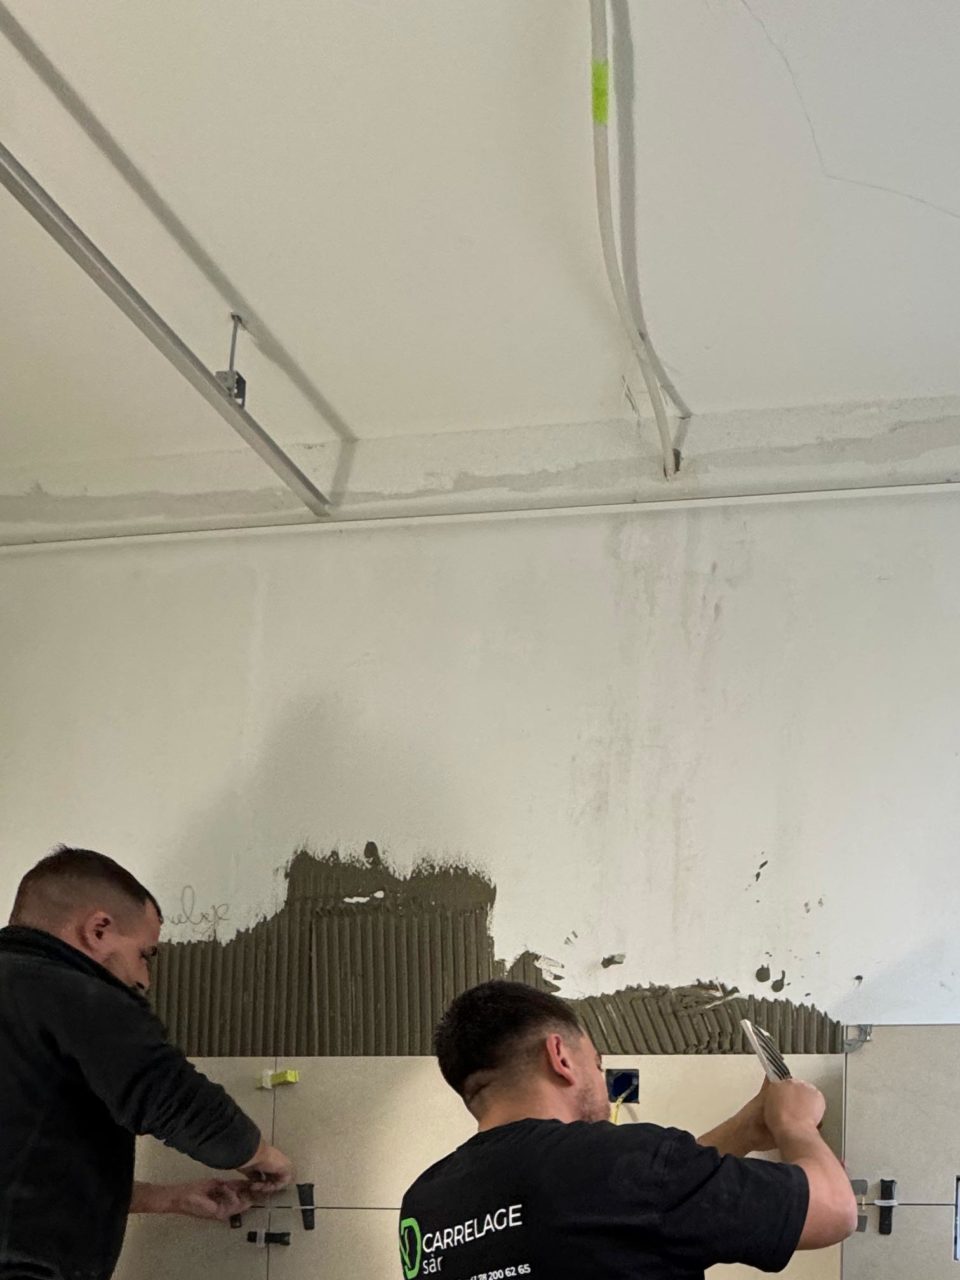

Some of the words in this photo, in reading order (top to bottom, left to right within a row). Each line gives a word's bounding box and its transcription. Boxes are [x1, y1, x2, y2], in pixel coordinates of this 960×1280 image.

[422, 1203, 523, 1254] CARRELAGE
[505, 1266, 517, 1278] 62
[517, 1263, 531, 1275] 65
